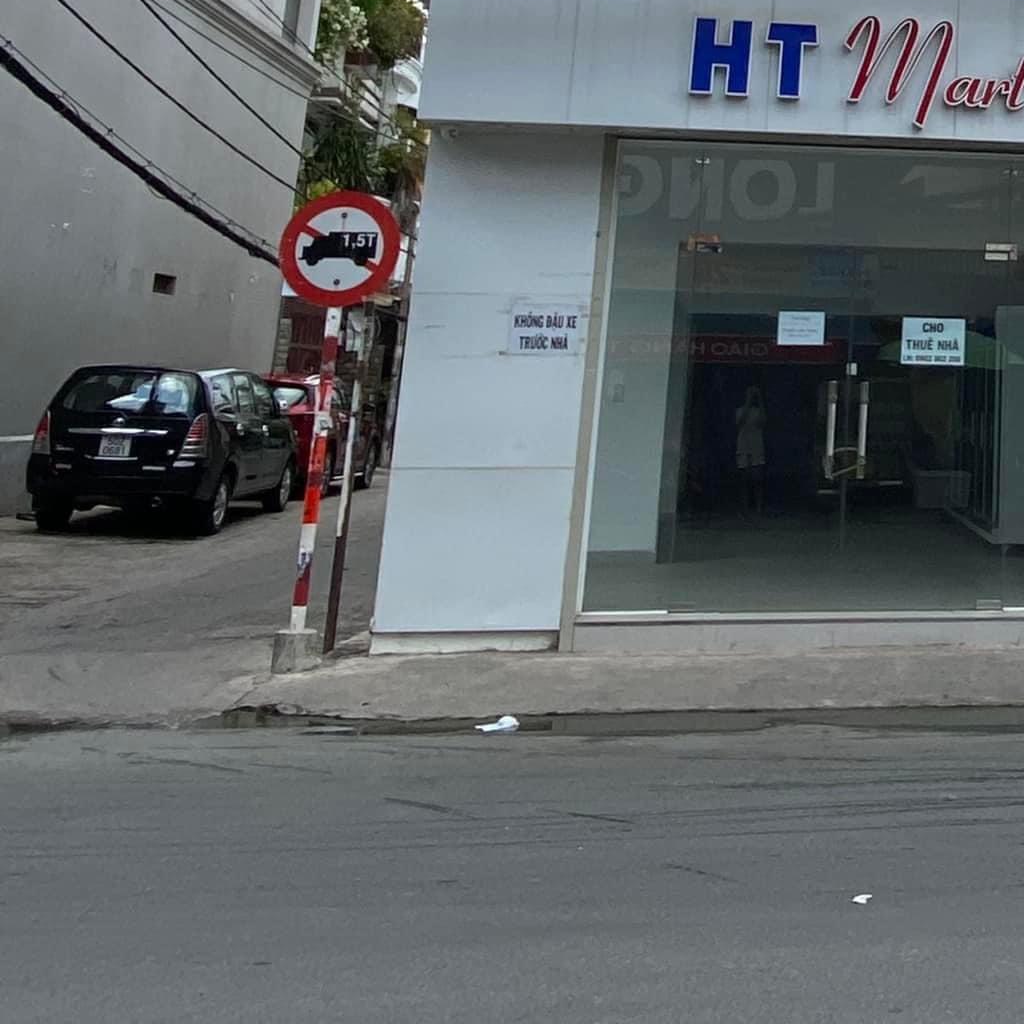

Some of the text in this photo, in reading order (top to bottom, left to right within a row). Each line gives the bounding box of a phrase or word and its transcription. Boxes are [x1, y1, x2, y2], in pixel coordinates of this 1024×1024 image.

[688, 16, 821, 100] HT
[342, 233, 377, 249] 1,5T
[565, 315, 578, 329] XE
[922, 322, 944, 333] CHO
[906, 337, 959, 351] THUÊ NHÀ
